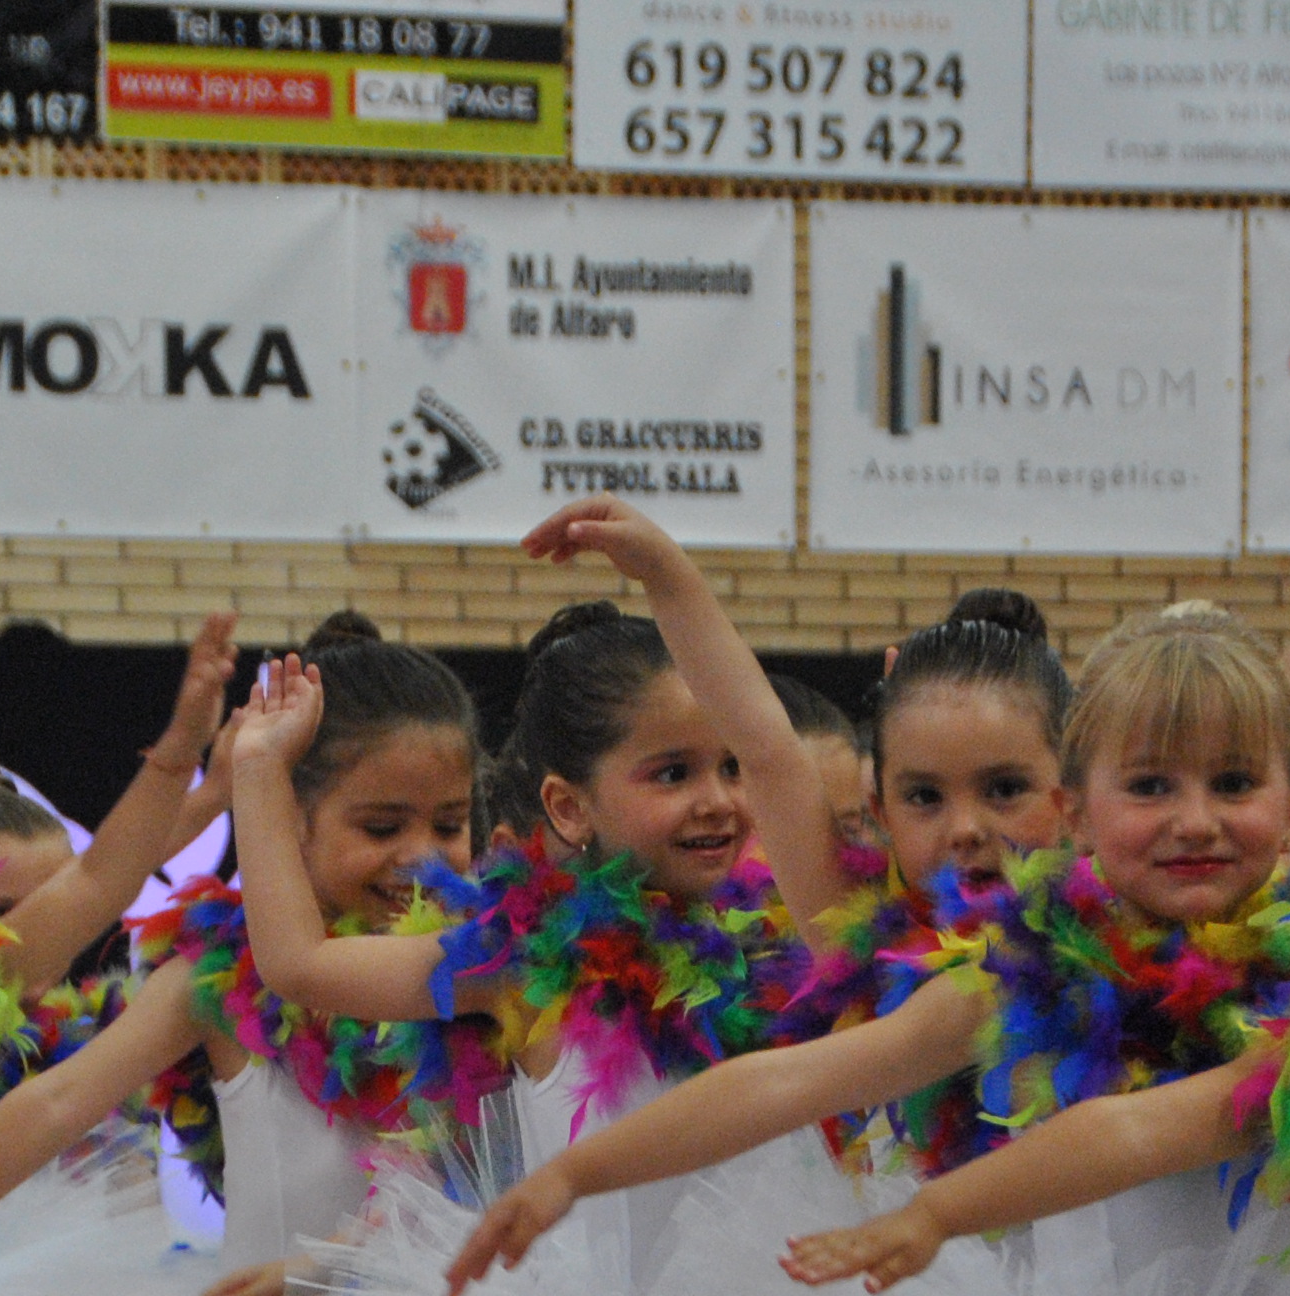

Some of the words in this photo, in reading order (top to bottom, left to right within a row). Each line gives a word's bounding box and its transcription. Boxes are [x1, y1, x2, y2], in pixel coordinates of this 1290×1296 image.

[259, 13, 322, 49] 941
[341, 17, 382, 53] 18
[392, 20, 437, 55] 08
[448, 23, 493, 56] 77
[1211, 1, 1247, 34] DE
[625, 39, 728, 91] 619
[746, 43, 846, 95] 507
[864, 48, 965, 99] 824
[26, 92, 87, 132] 167
[625, 106, 727, 156] 657
[746, 110, 846, 162] 315
[864, 116, 965, 165] 422
[573, 254, 754, 297] Ayuntamiento
[510, 303, 540, 337] de
[550, 303, 637, 339] Alfaro
[953, 364, 1093, 409] INSA
[1116, 366, 1198, 412] DM
[576, 418, 763, 453] GRACCURRIS
[541, 460, 658, 493] FUTBOL
[666, 463, 741, 494] SALA
